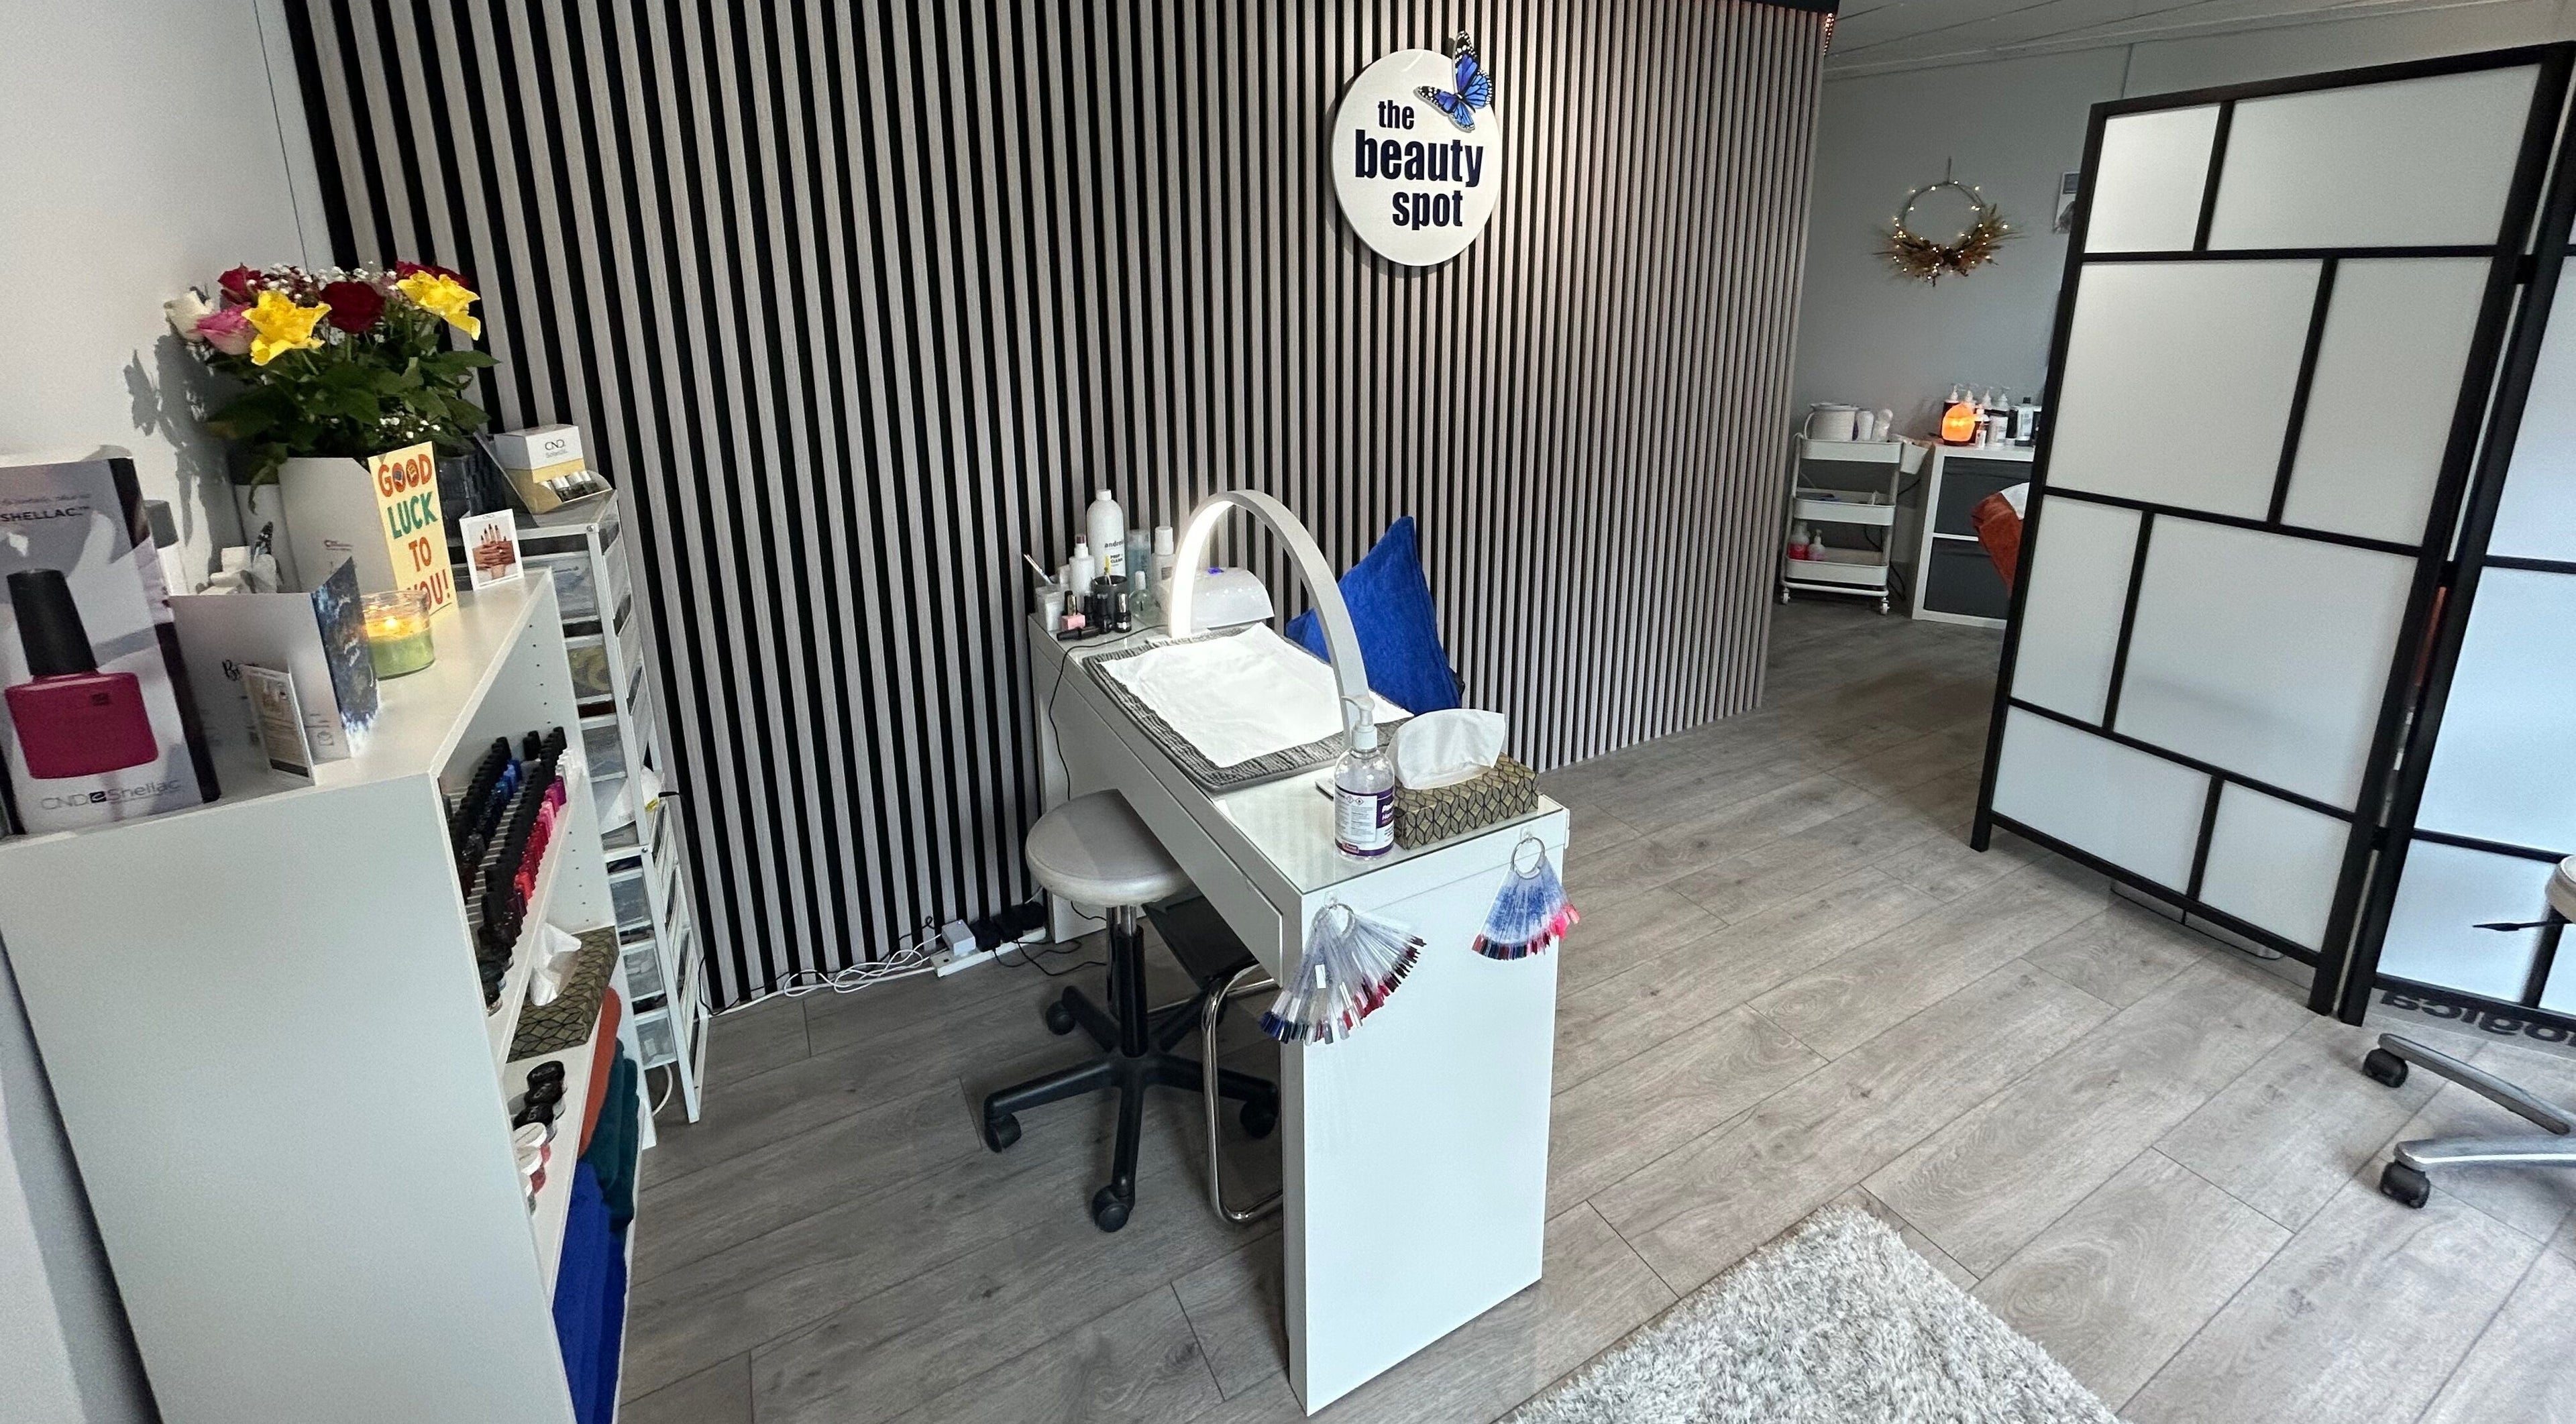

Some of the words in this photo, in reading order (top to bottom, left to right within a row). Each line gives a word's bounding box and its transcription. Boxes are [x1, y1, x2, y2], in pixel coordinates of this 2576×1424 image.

[1378, 100, 1415, 130] the
[1355, 129, 1484, 188] beauty
[1392, 190, 1464, 231] spot
[378, 453, 433, 498] GOOD
[386, 490, 438, 540] LUCK
[408, 536, 432, 572] TO
